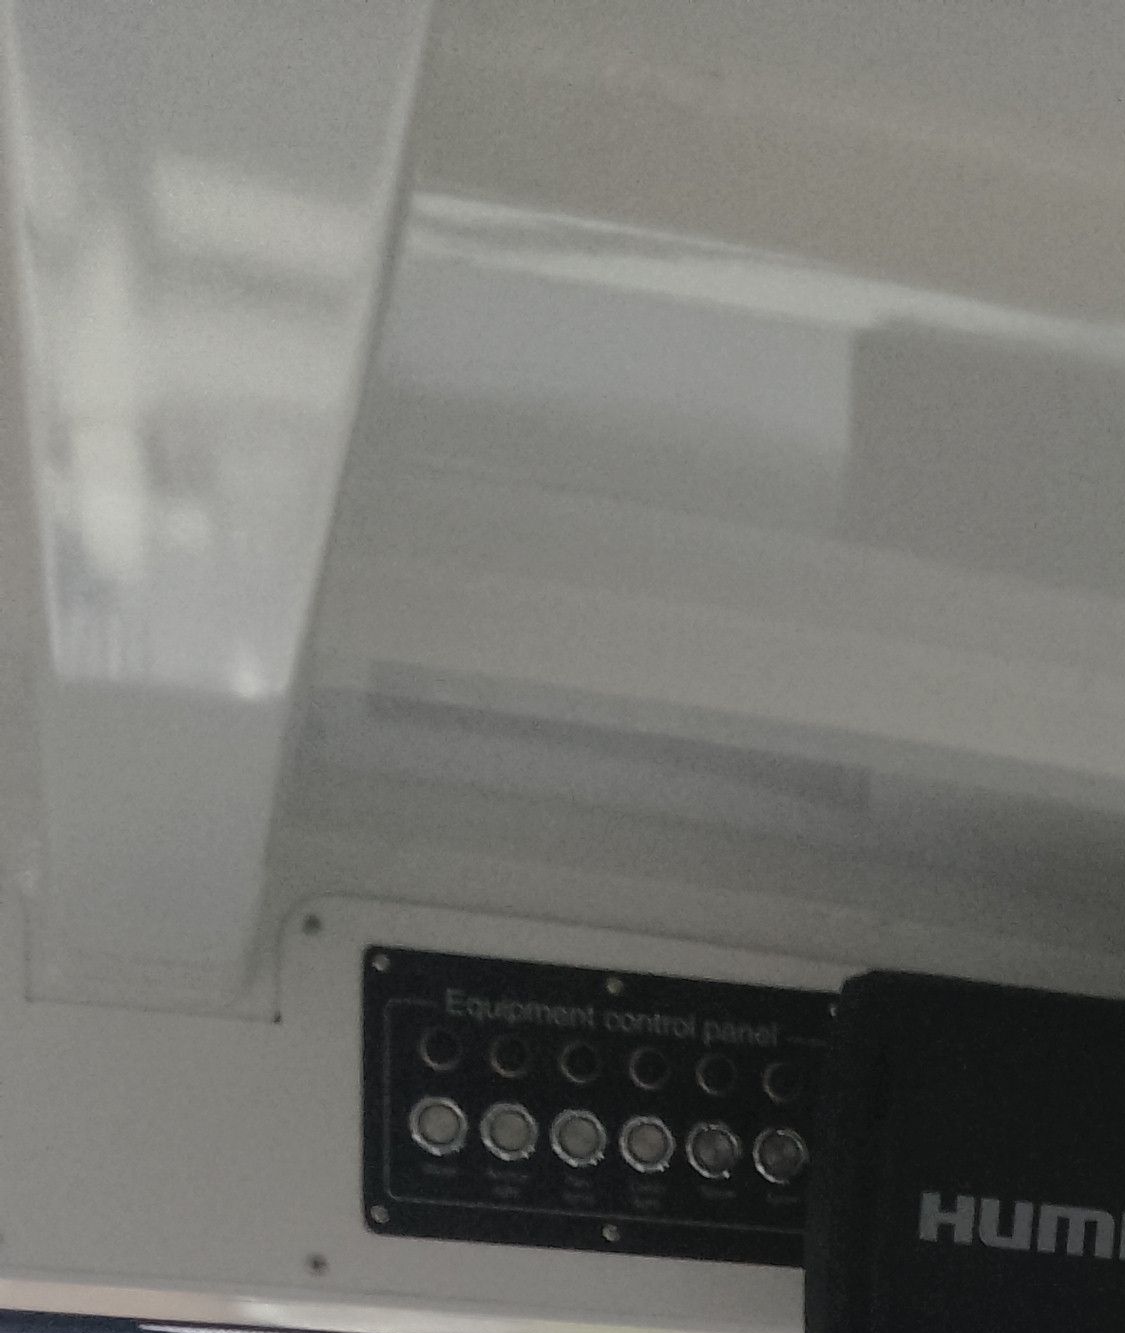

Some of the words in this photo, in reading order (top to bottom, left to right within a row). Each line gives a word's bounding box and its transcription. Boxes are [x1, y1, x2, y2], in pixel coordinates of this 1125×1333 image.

[445, 988, 595, 1027] Equipment
[604, 1006, 697, 1039] control
[702, 1018, 779, 1047] panel
